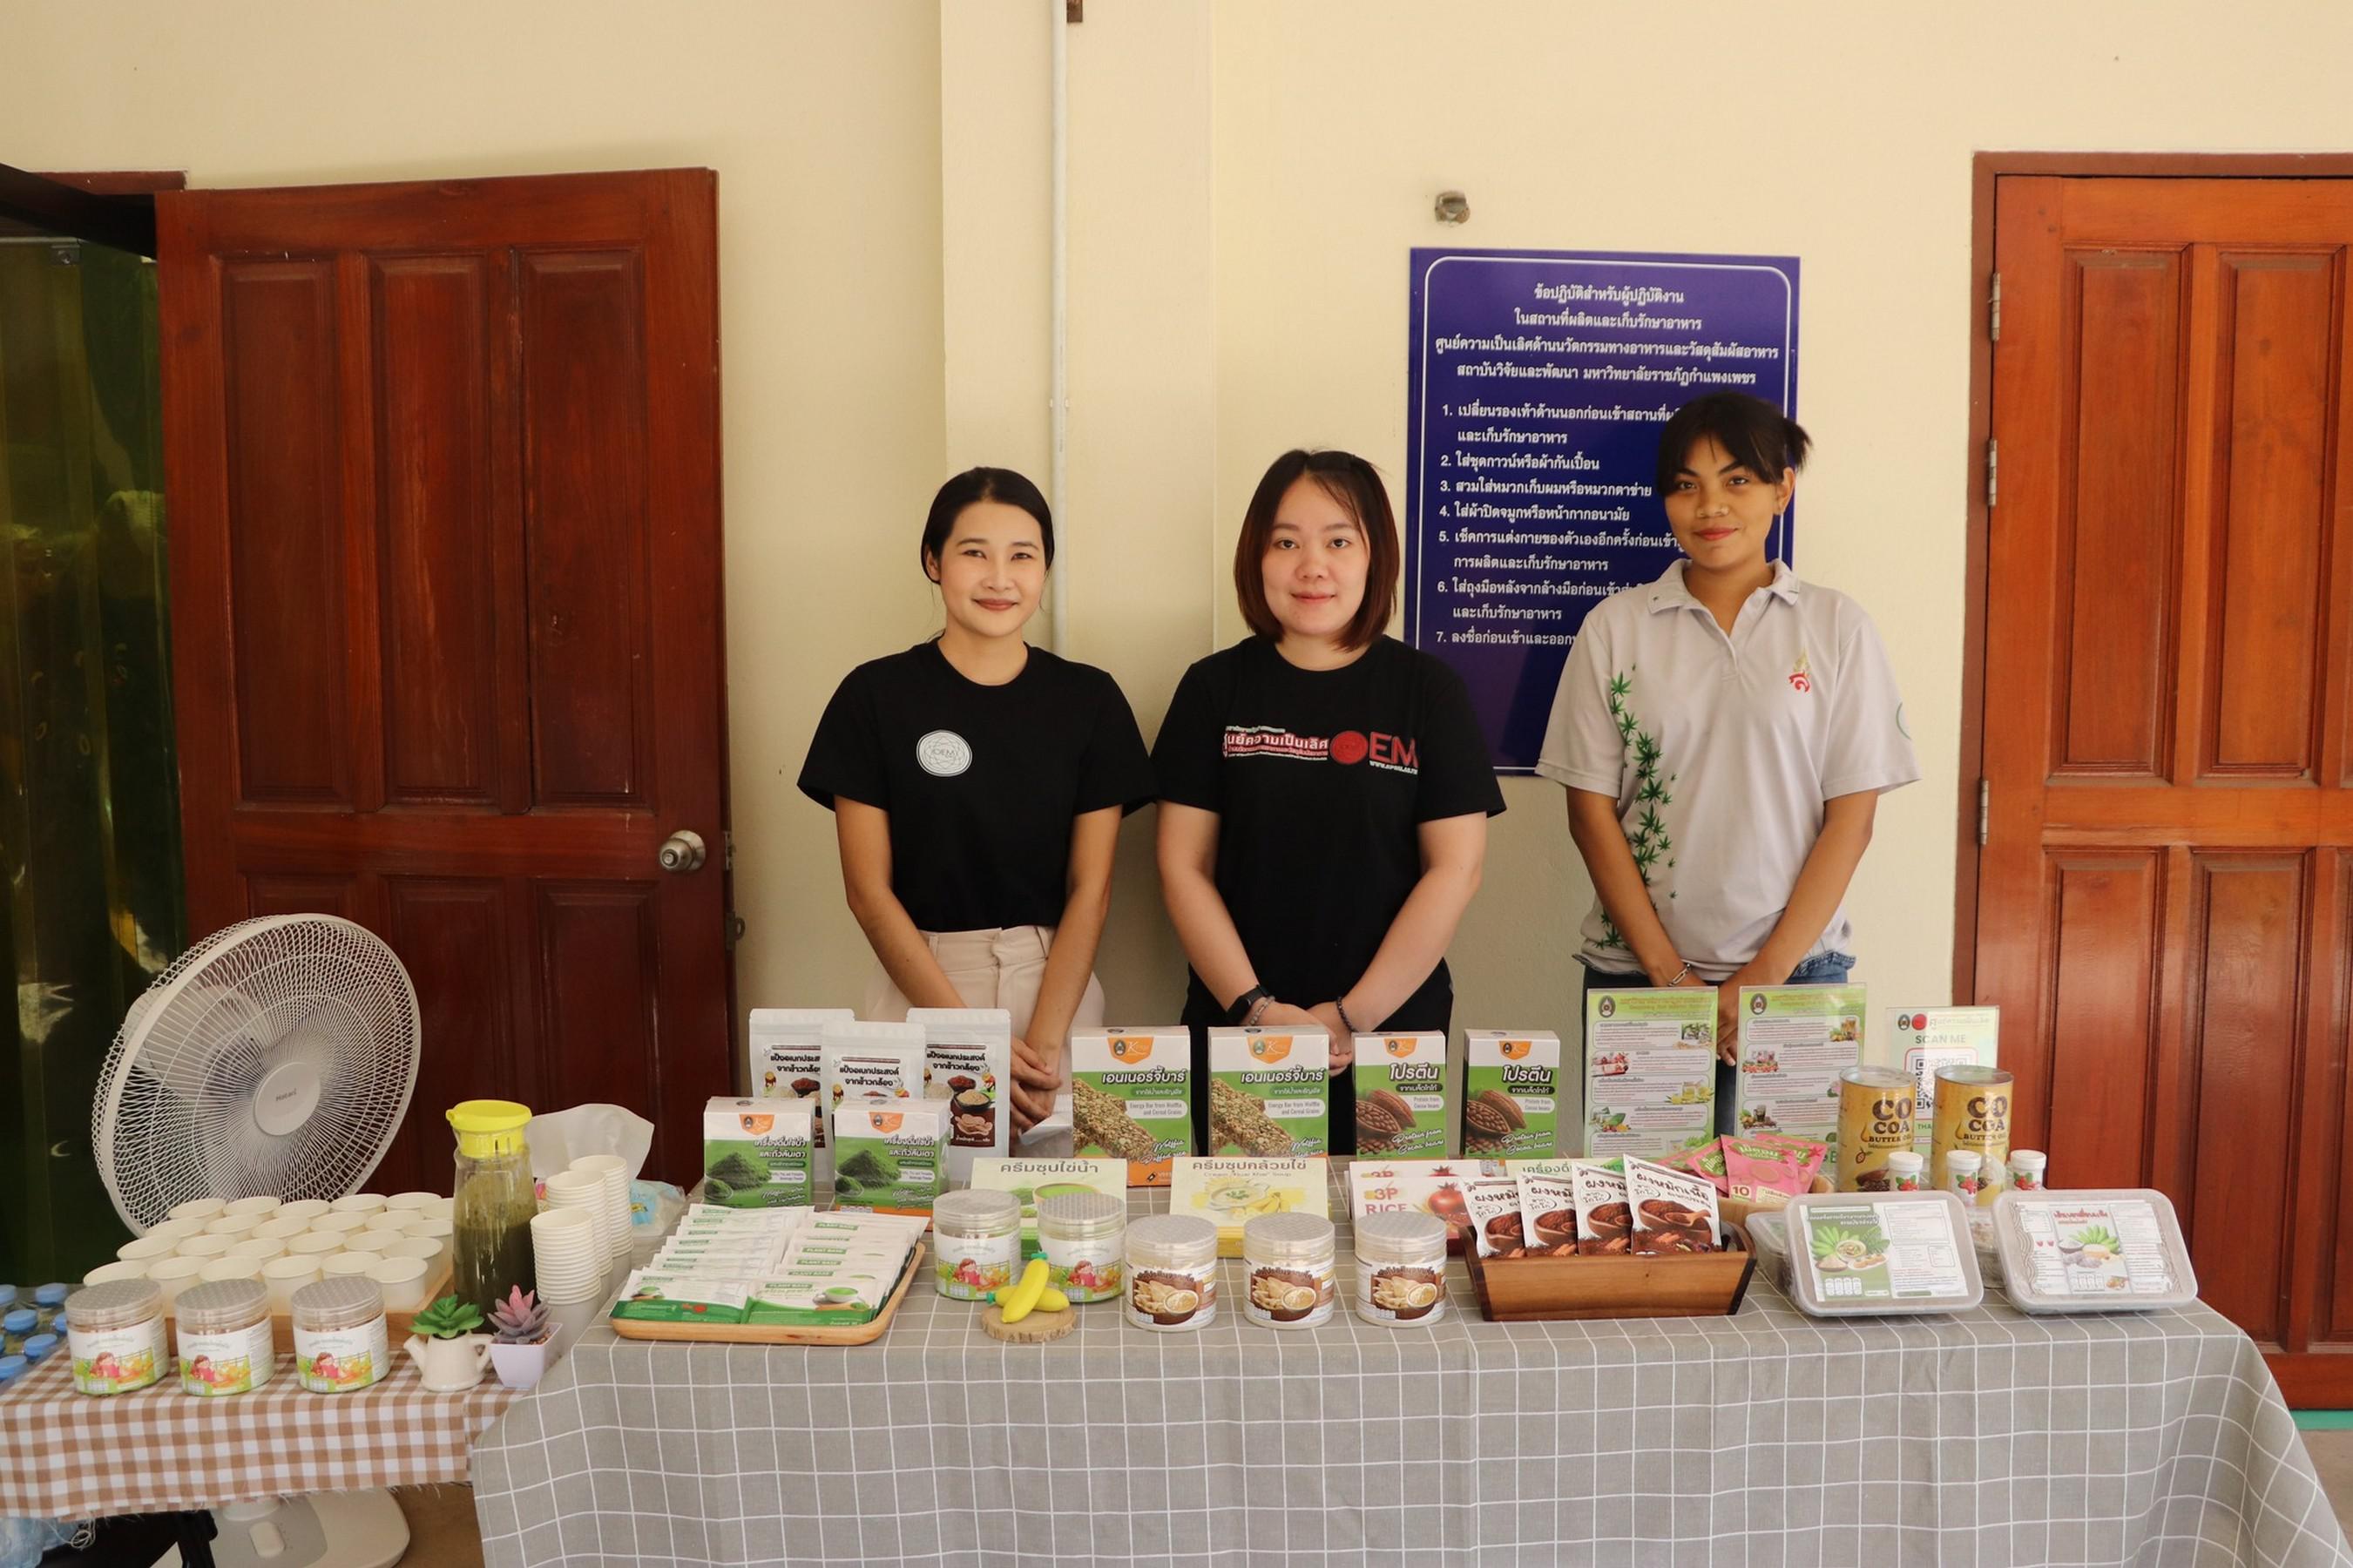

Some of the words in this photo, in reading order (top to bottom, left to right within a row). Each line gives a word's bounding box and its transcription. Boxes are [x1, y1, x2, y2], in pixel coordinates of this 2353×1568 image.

[1534, 282, 1684, 307] ข้อปฏิบัติสำหรับผู้ปฏิบัติงาน
[1514, 307, 1702, 330] ในสถานที่ผลิตและเก็บรักษาอาหาร
[1436, 334, 1779, 362] ศูนย์ความเป็นเลิศด้านนวัตกรรมทางอาหารและวัสดุสัมผัสอาหาร
[1457, 361, 1579, 379] สถาบันวิจัยและพัฒนา
[1583, 364, 1756, 387] มหาวิทยาลัยราชภัฏกำแพงเพชร
[1442, 404, 1453, 416] 1.
[1457, 426, 1568, 443] และเก็บรักษาอาหาร
[1441, 455, 1451, 467] 2.
[1456, 450, 1599, 471] ใส่ชุดกาวน์หรือผ้ากันเปื้อน
[1440, 481, 1450, 492] 3.
[1456, 476, 1652, 497] สวมใส่หมวกเก็บผมหรือหมวกตาข่าย
[1439, 506, 1450, 517] 4.
[1455, 501, 1630, 523] ใส่ผ้าปิดจมูกหรือหน้ากากอนามัย
[1438, 531, 1450, 542] 5.
[1454, 554, 1609, 571] การผลิตและเก็บรักษาอาหาร
[1437, 581, 1448, 592] 6.
[1453, 605, 1562, 619] และเก็บรักษาอาหาร
[1437, 632, 1447, 643] 7.
[1915, 1035, 1948, 1044] SCAN
[1950, 1034, 1966, 1044] ME
[1102, 1065, 1187, 1083] เอนเนอร์จี้บาร์
[1241, 1065, 1325, 1083] เอนเนอร์จี้บาร์
[1389, 1063, 1439, 1080] โปรตีน
[1503, 1065, 1552, 1083] โปรตีน
[845, 1077, 893, 1087] จากข้าวกล้อง
[1001, 1159, 1099, 1175] ครีมซุปไข่น้ำ
[1193, 1159, 1307, 1173] ครีมซุปกล้วยไข่
[1374, 1188, 1398, 1200] 3P
[1732, 1186, 1750, 1197] 10
